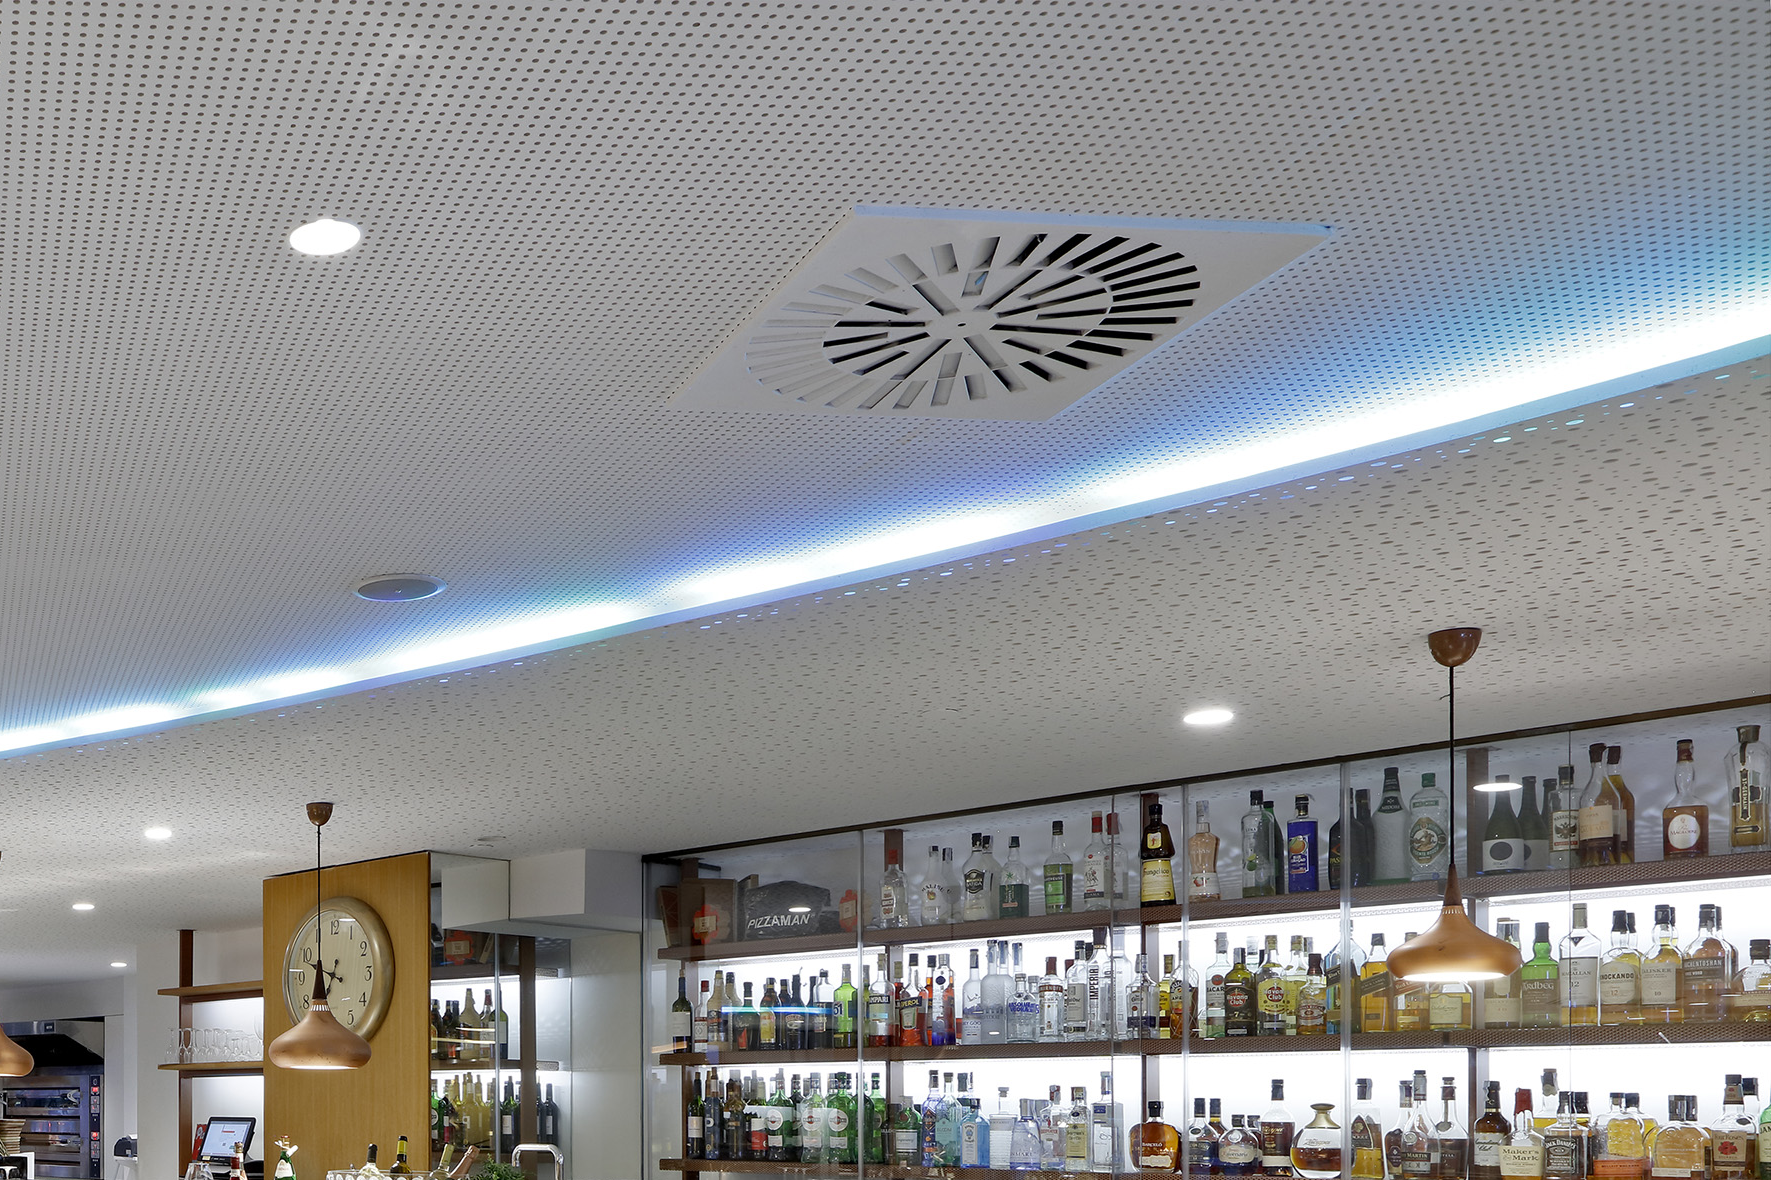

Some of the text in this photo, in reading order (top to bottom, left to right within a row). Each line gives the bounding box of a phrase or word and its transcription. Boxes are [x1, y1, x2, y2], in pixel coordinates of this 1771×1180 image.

[330, 919, 340, 935] 12
[747, 913, 812, 930] PIZZAMAN
[302, 947, 312, 962] 10
[359, 941, 368, 957] 2
[298, 971, 305, 985] 9
[364, 965, 372, 981] 3
[1089, 967, 1099, 1000] IMPERIA
[302, 994, 310, 1009] 8
[358, 992, 367, 1006] 4
[347, 1010, 354, 1025] 5
